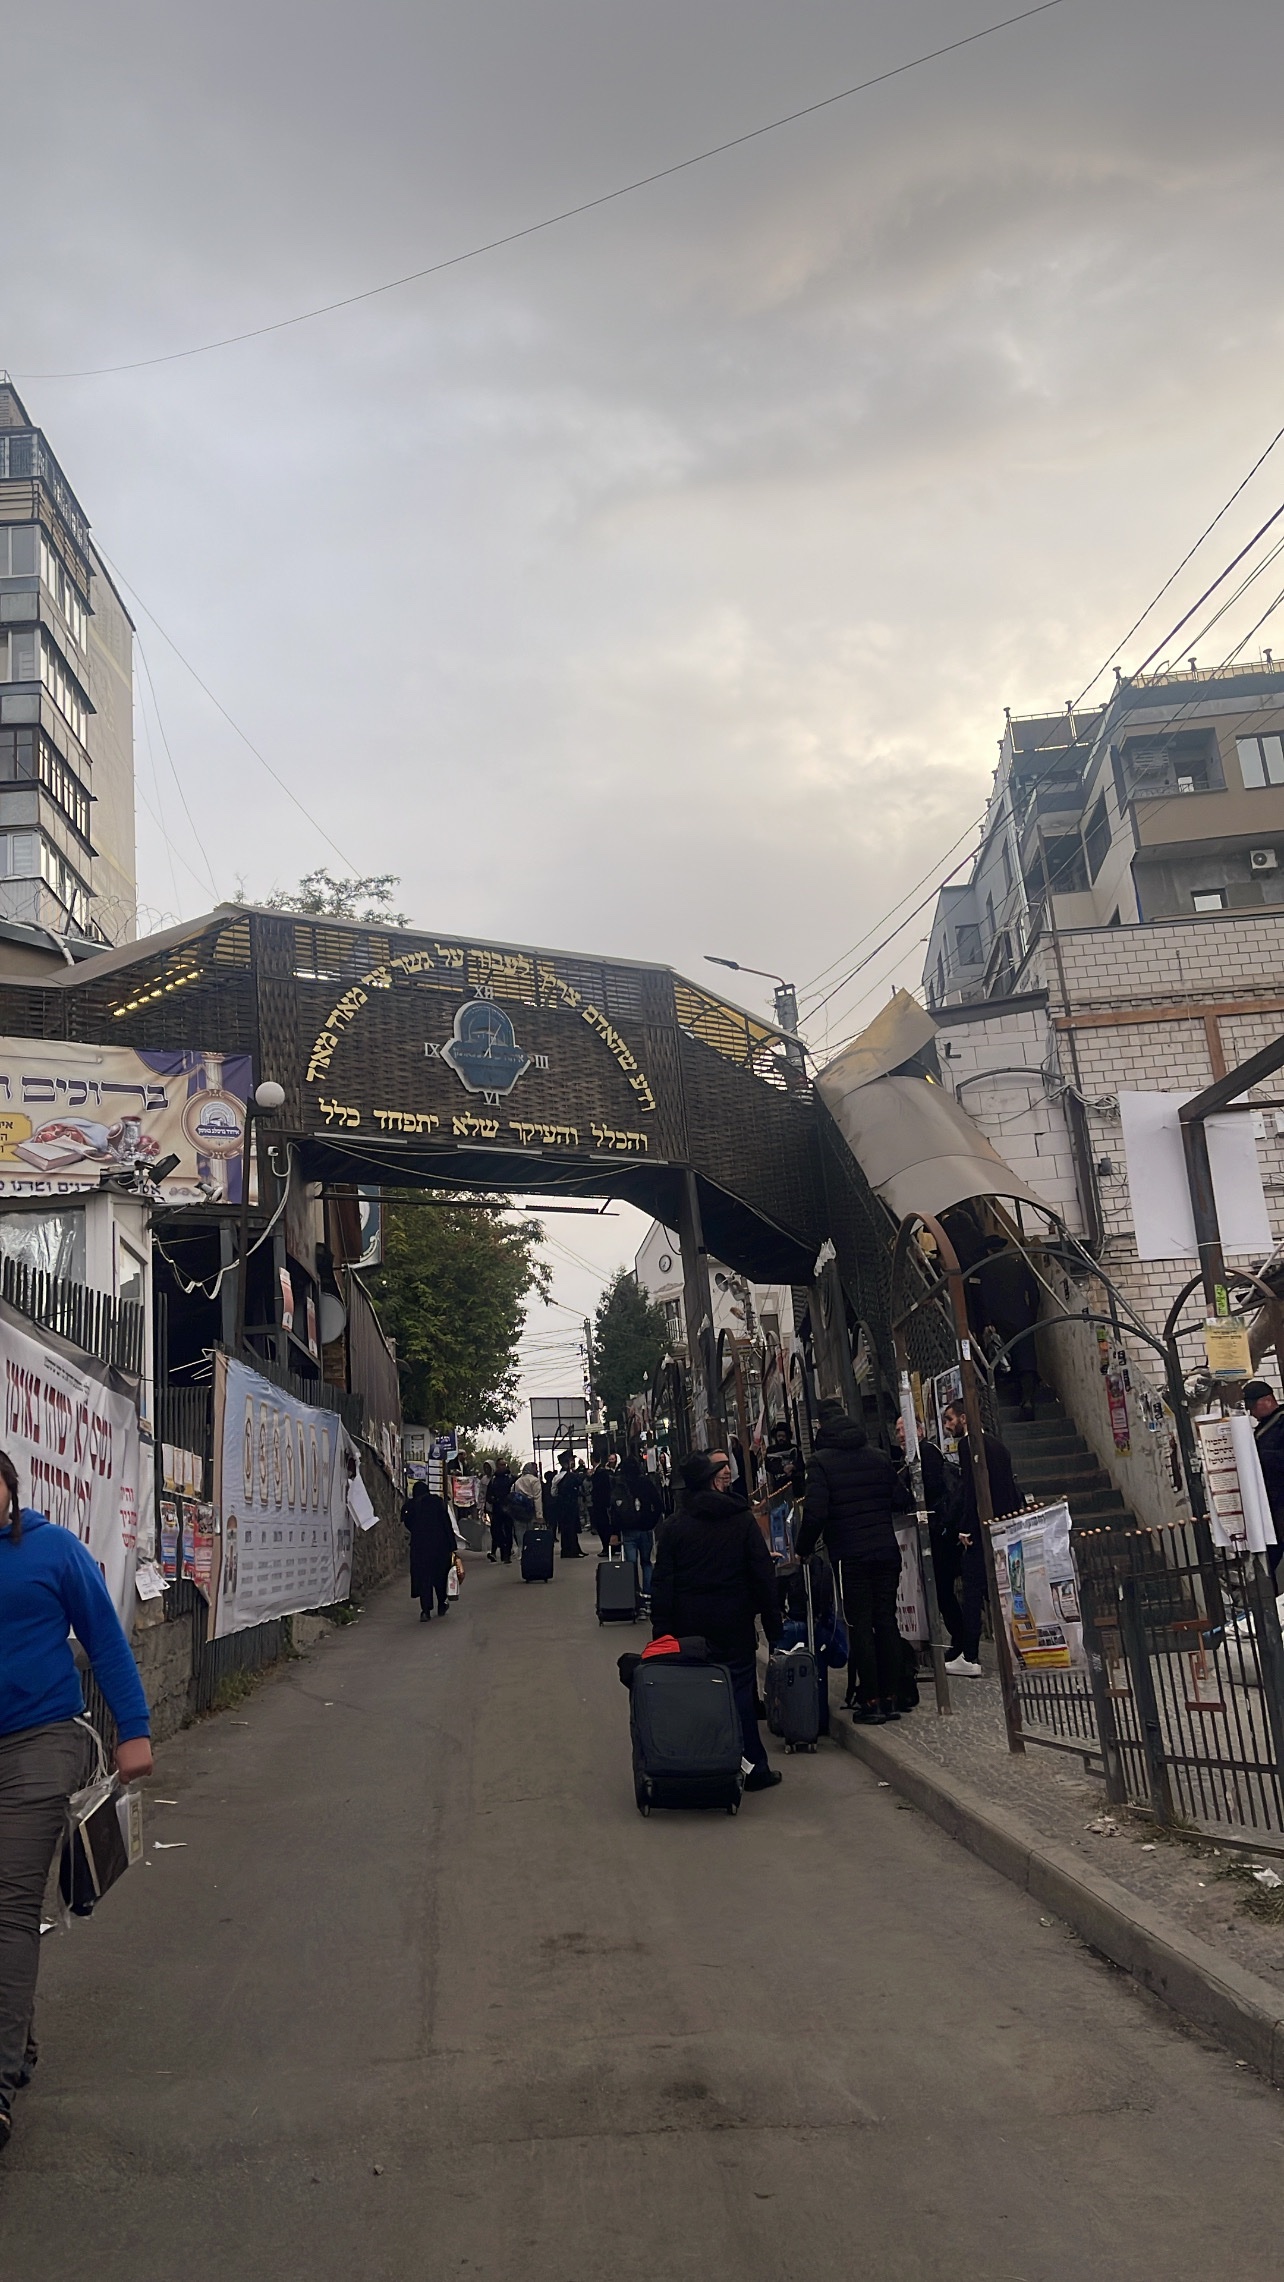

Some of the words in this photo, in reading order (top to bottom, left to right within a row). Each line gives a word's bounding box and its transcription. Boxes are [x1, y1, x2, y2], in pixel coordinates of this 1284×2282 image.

[390, 951, 435, 975] גשר
[434, 943, 465, 967] על
[470, 949, 530, 976] לעבור
[361, 966, 393, 985] צר
[324, 986, 369, 1031] מאוד
[424, 1042, 441, 1058] IX
[581, 1004, 638, 1071] שהאדם
[305, 1031, 339, 1082] מאוד
[534, 1054, 550, 1070] III
[20, 1074, 170, 1112] ברוכים
[629, 1073, 656, 1112] ודע
[318, 1097, 361, 1127] כלל
[373, 1109, 440, 1134] יתפחד
[452, 1110, 500, 1138] שלא
[509, 1121, 579, 1146] והעיקר
[590, 1122, 648, 1151] והכלל
